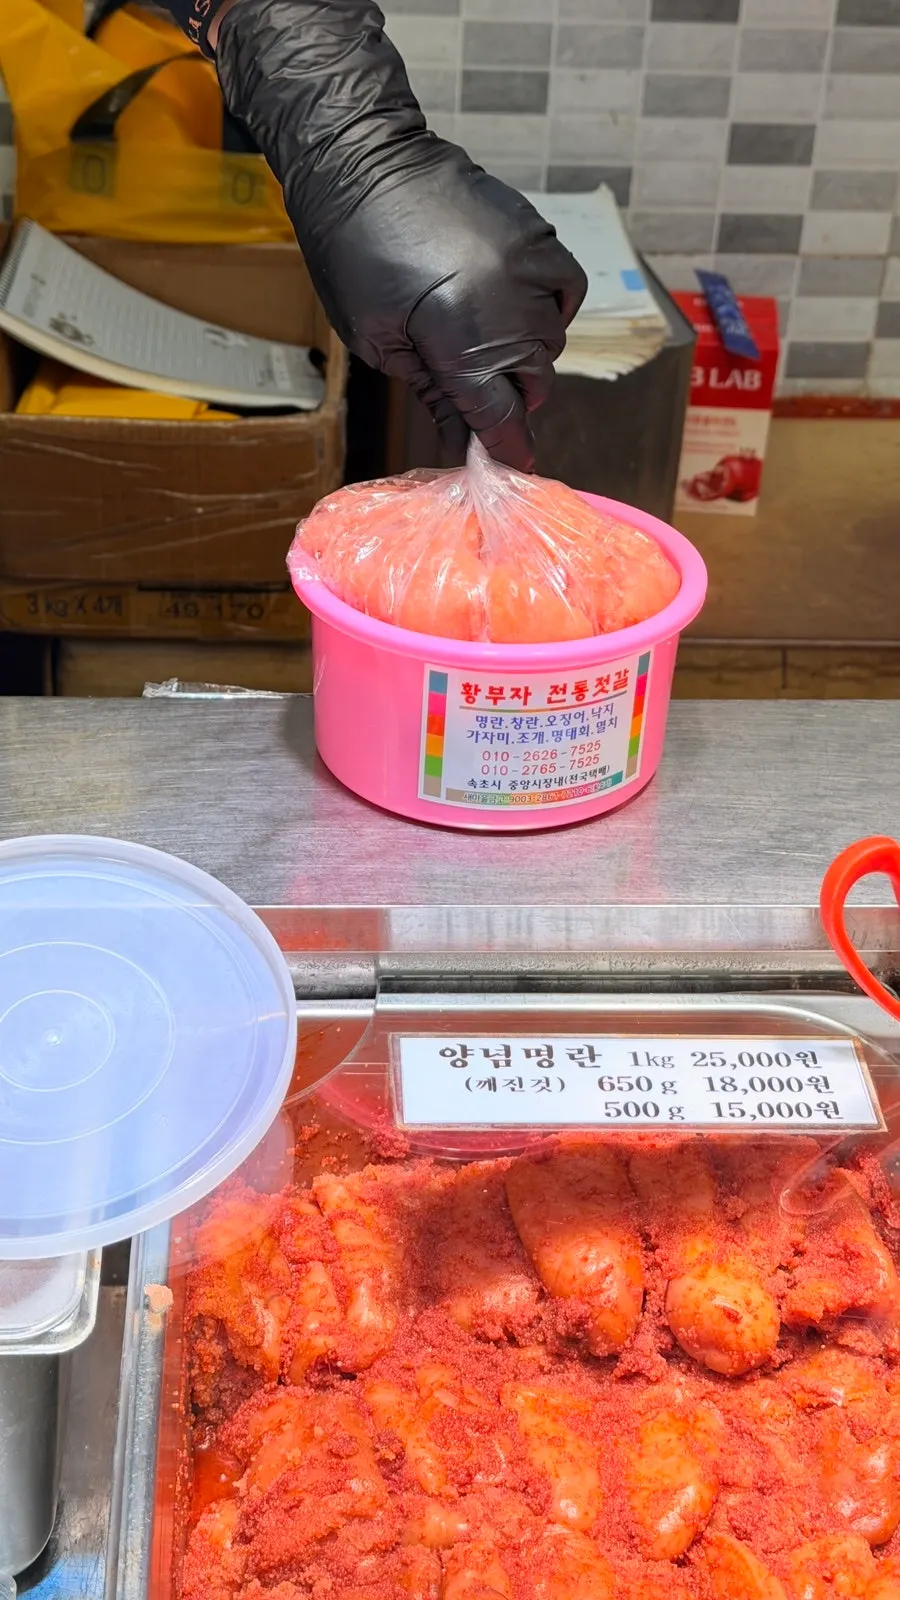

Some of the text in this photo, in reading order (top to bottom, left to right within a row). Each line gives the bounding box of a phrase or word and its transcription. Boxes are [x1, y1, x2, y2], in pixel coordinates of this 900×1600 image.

[709, 367, 762, 391] LAB
[460, 668, 630, 706] 황부자 전통젓갈
[467, 778, 501, 791] 속초시
[438, 1043, 822, 1070] 양념명란 1kg 25,000원
[464, 1076, 566, 1094] (깨진것)
[704, 1075, 835, 1095] 18,000원
[713, 1100, 843, 1120] 15,000원
